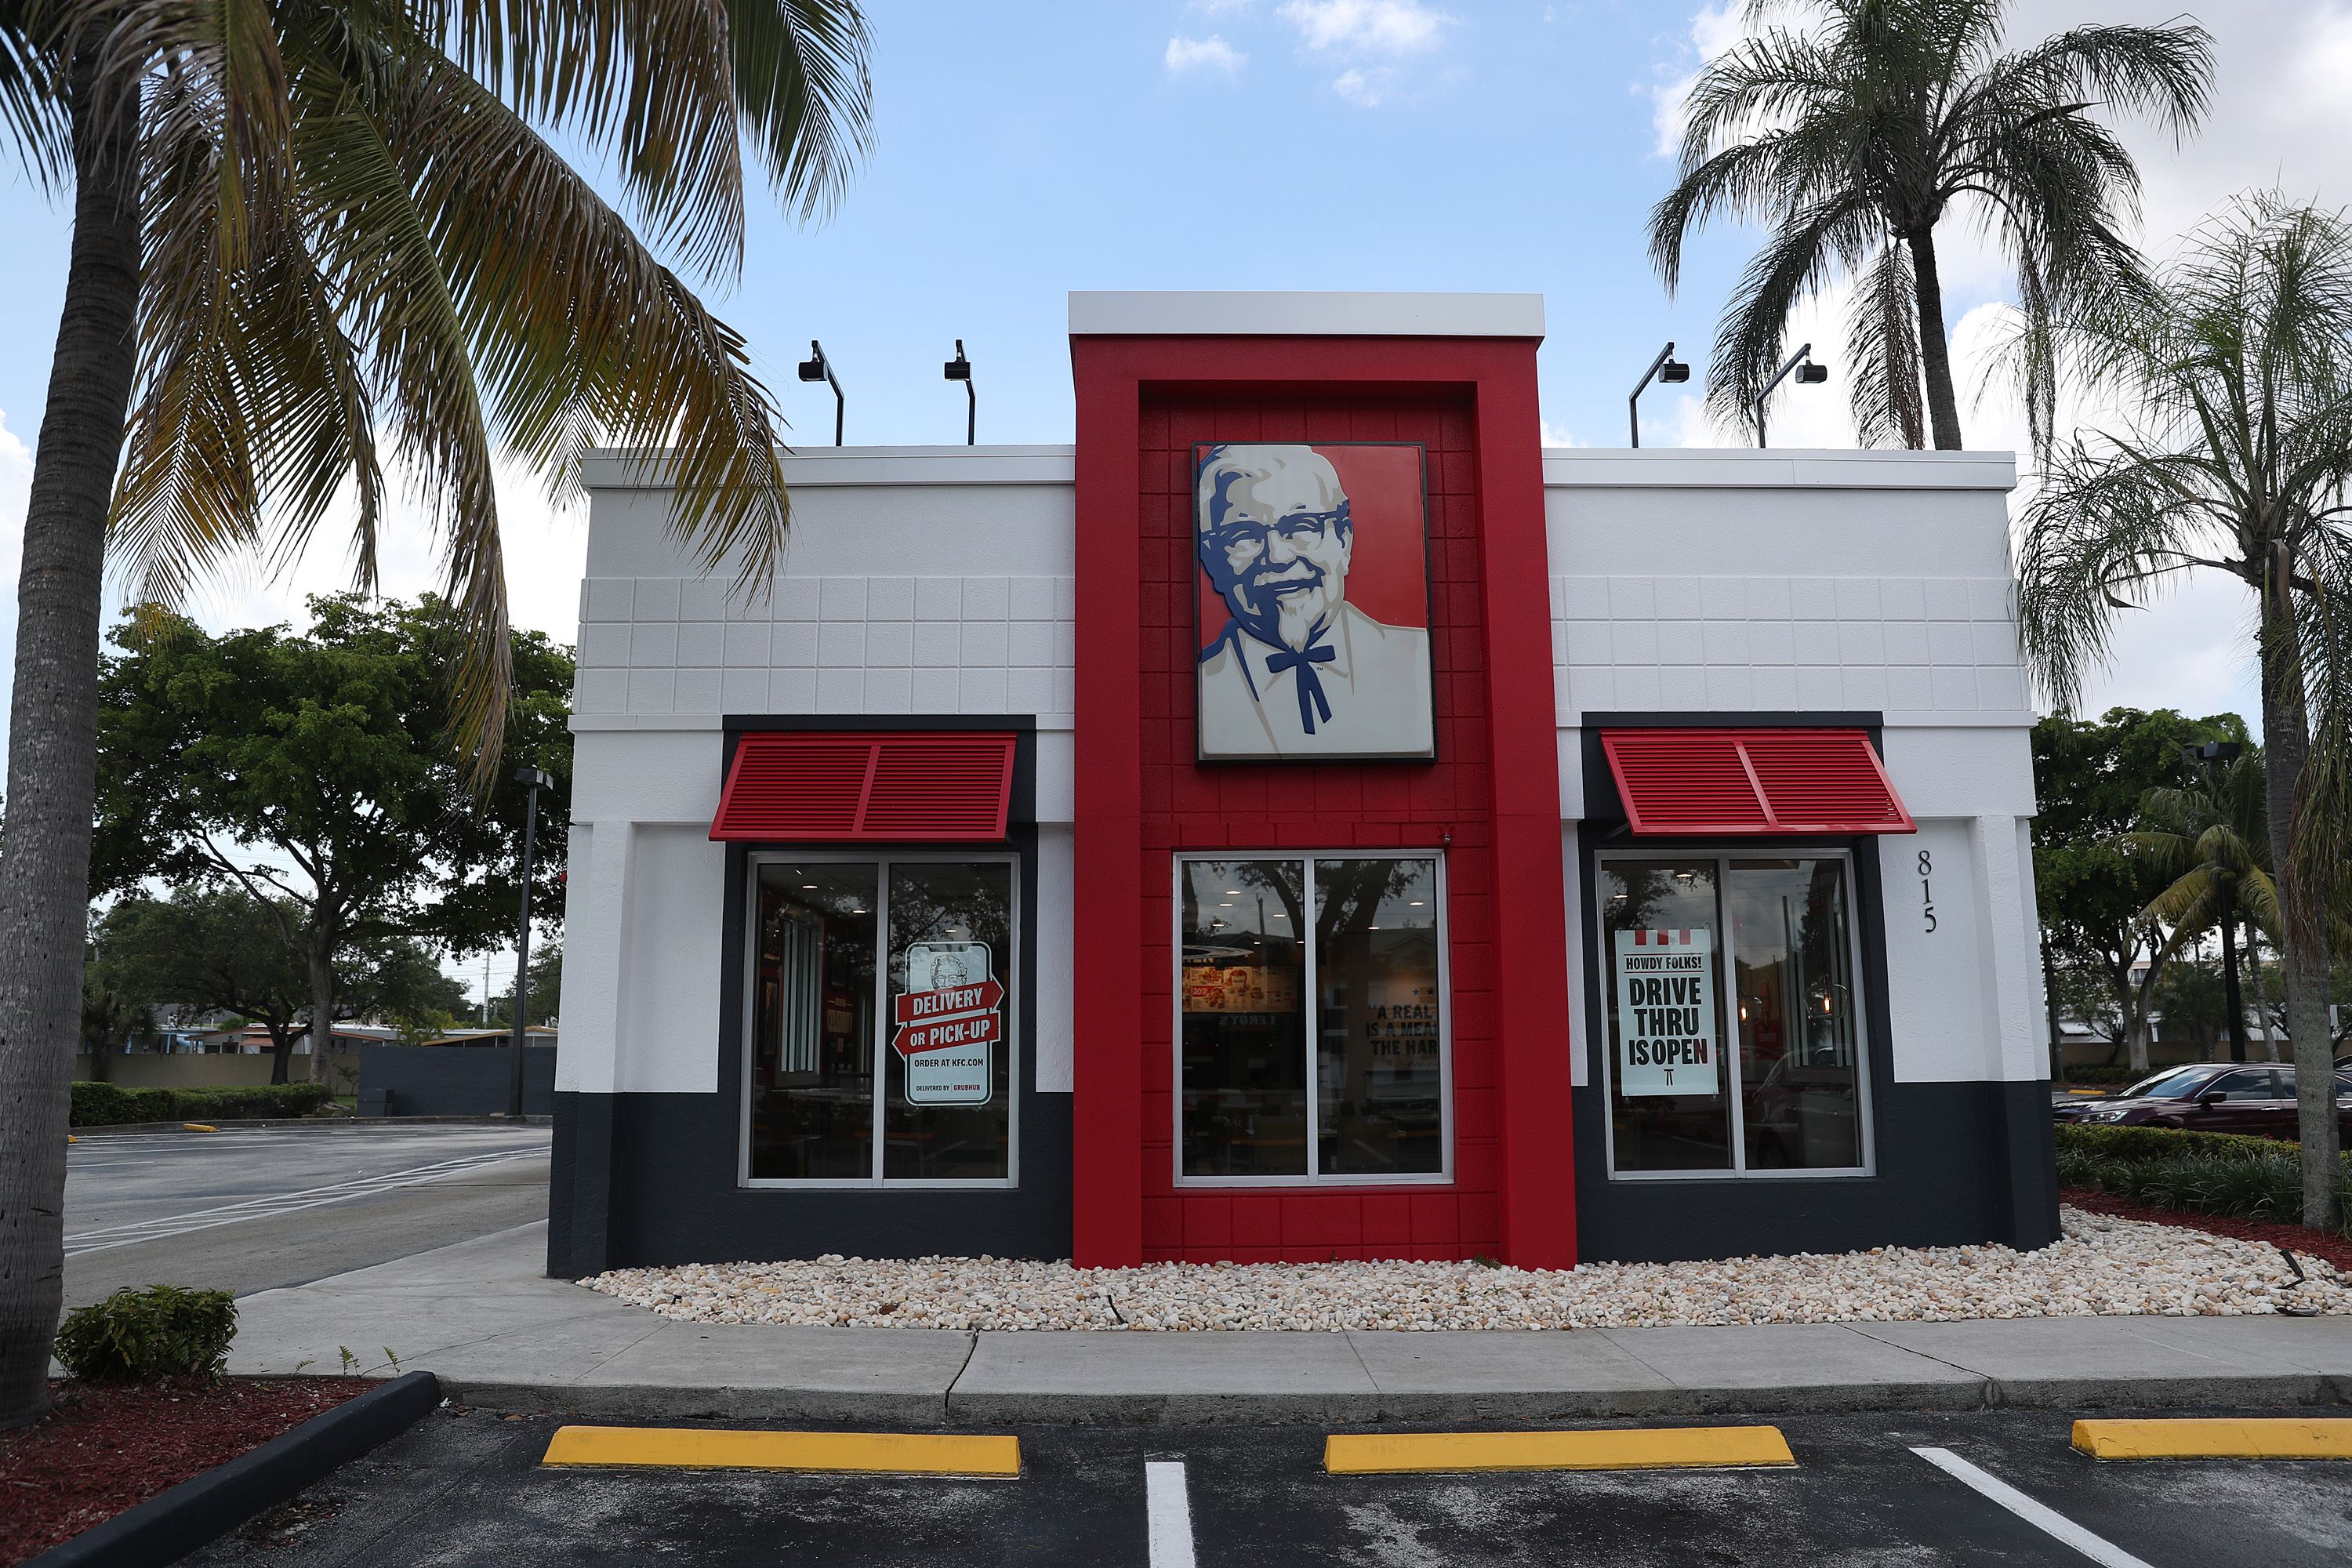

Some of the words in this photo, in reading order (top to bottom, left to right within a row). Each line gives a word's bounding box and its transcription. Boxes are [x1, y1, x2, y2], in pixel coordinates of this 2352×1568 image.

[1918, 850, 1936, 934] 815
[1625, 957, 1662, 970] HOWDY
[1666, 956, 1702, 969] FOLKS!
[913, 987, 983, 1016] DELIVERY
[1628, 977, 1701, 1006] DRIVE
[1392, 1004, 1432, 1019] REAL
[1633, 1007, 1700, 1036] THRU
[909, 1032, 926, 1047] OR
[930, 1019, 990, 1046] PICK-UP
[1366, 1022, 1379, 1037] IS
[1385, 1022, 1396, 1036] A
[1370, 1040, 1400, 1055] THE
[1628, 1040, 1650, 1065] IS
[1651, 1038, 1708, 1065] OPEN
